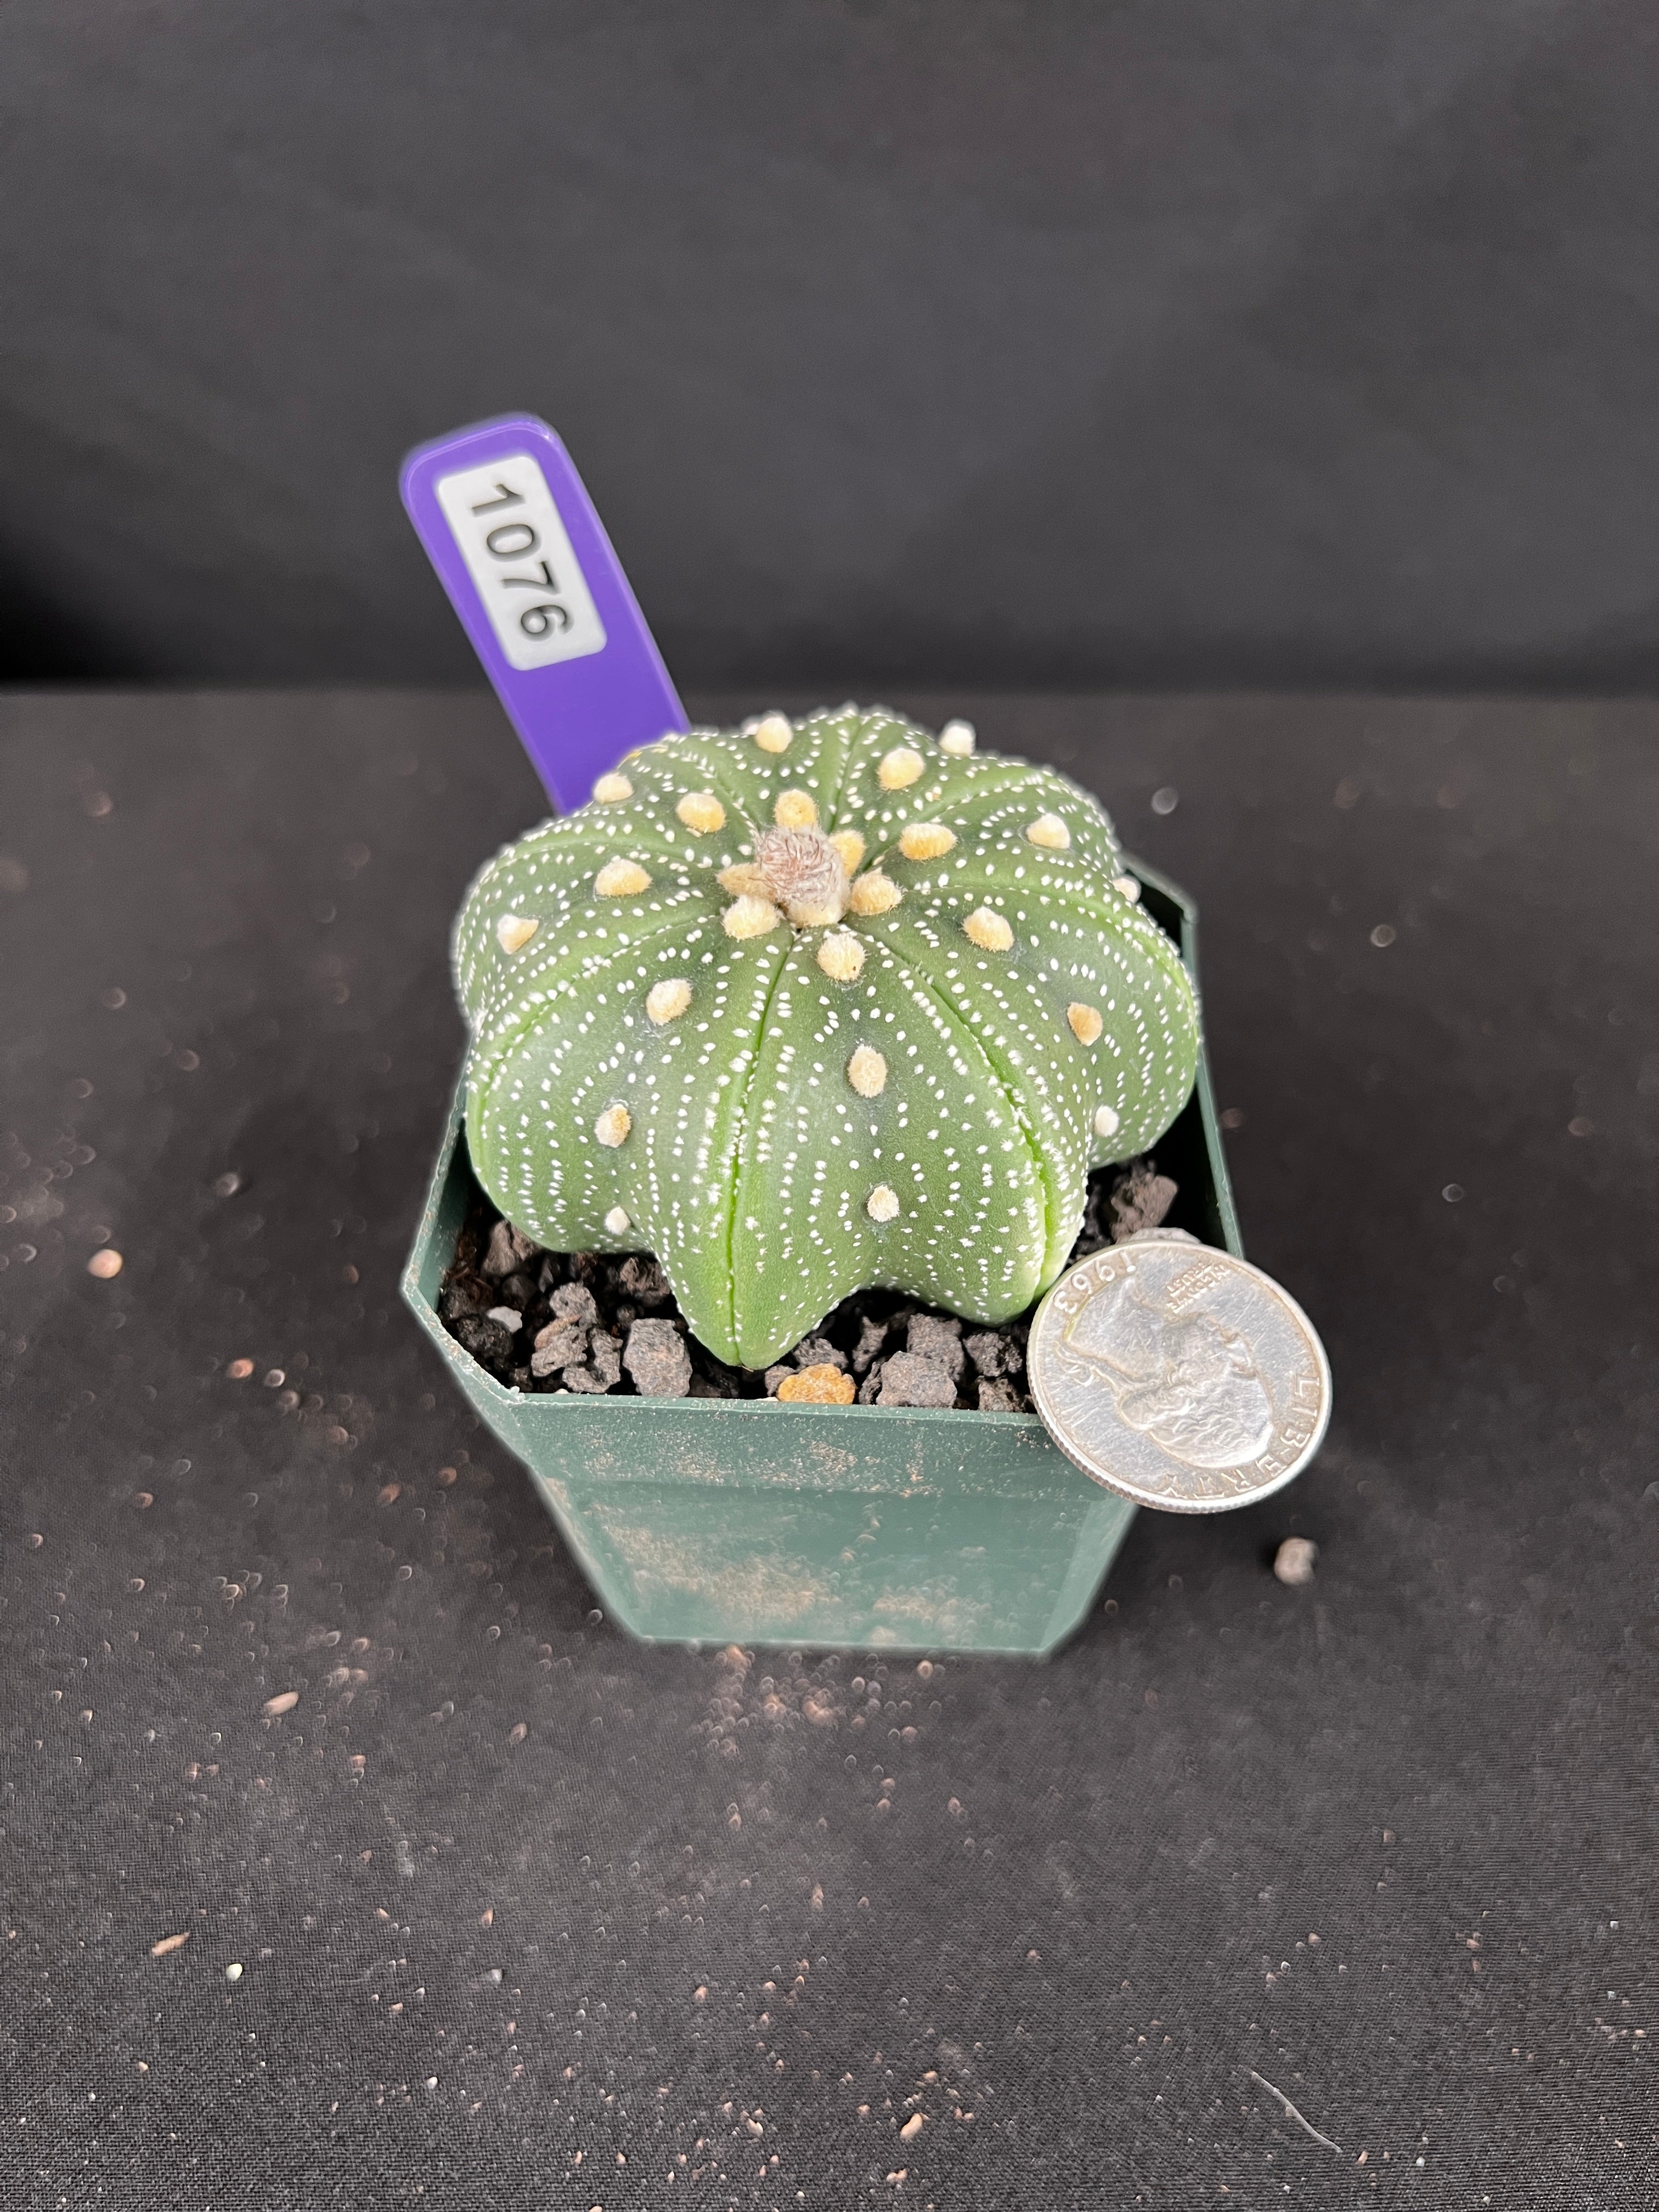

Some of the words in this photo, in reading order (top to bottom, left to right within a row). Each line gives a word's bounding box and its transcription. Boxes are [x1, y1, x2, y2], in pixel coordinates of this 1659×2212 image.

[469, 483, 575, 641] 1076
[1054, 1252, 1136, 1314] 1963
[1166, 1262, 1212, 1297] TRUST
[1156, 1371, 1320, 1499] LIBERTY
